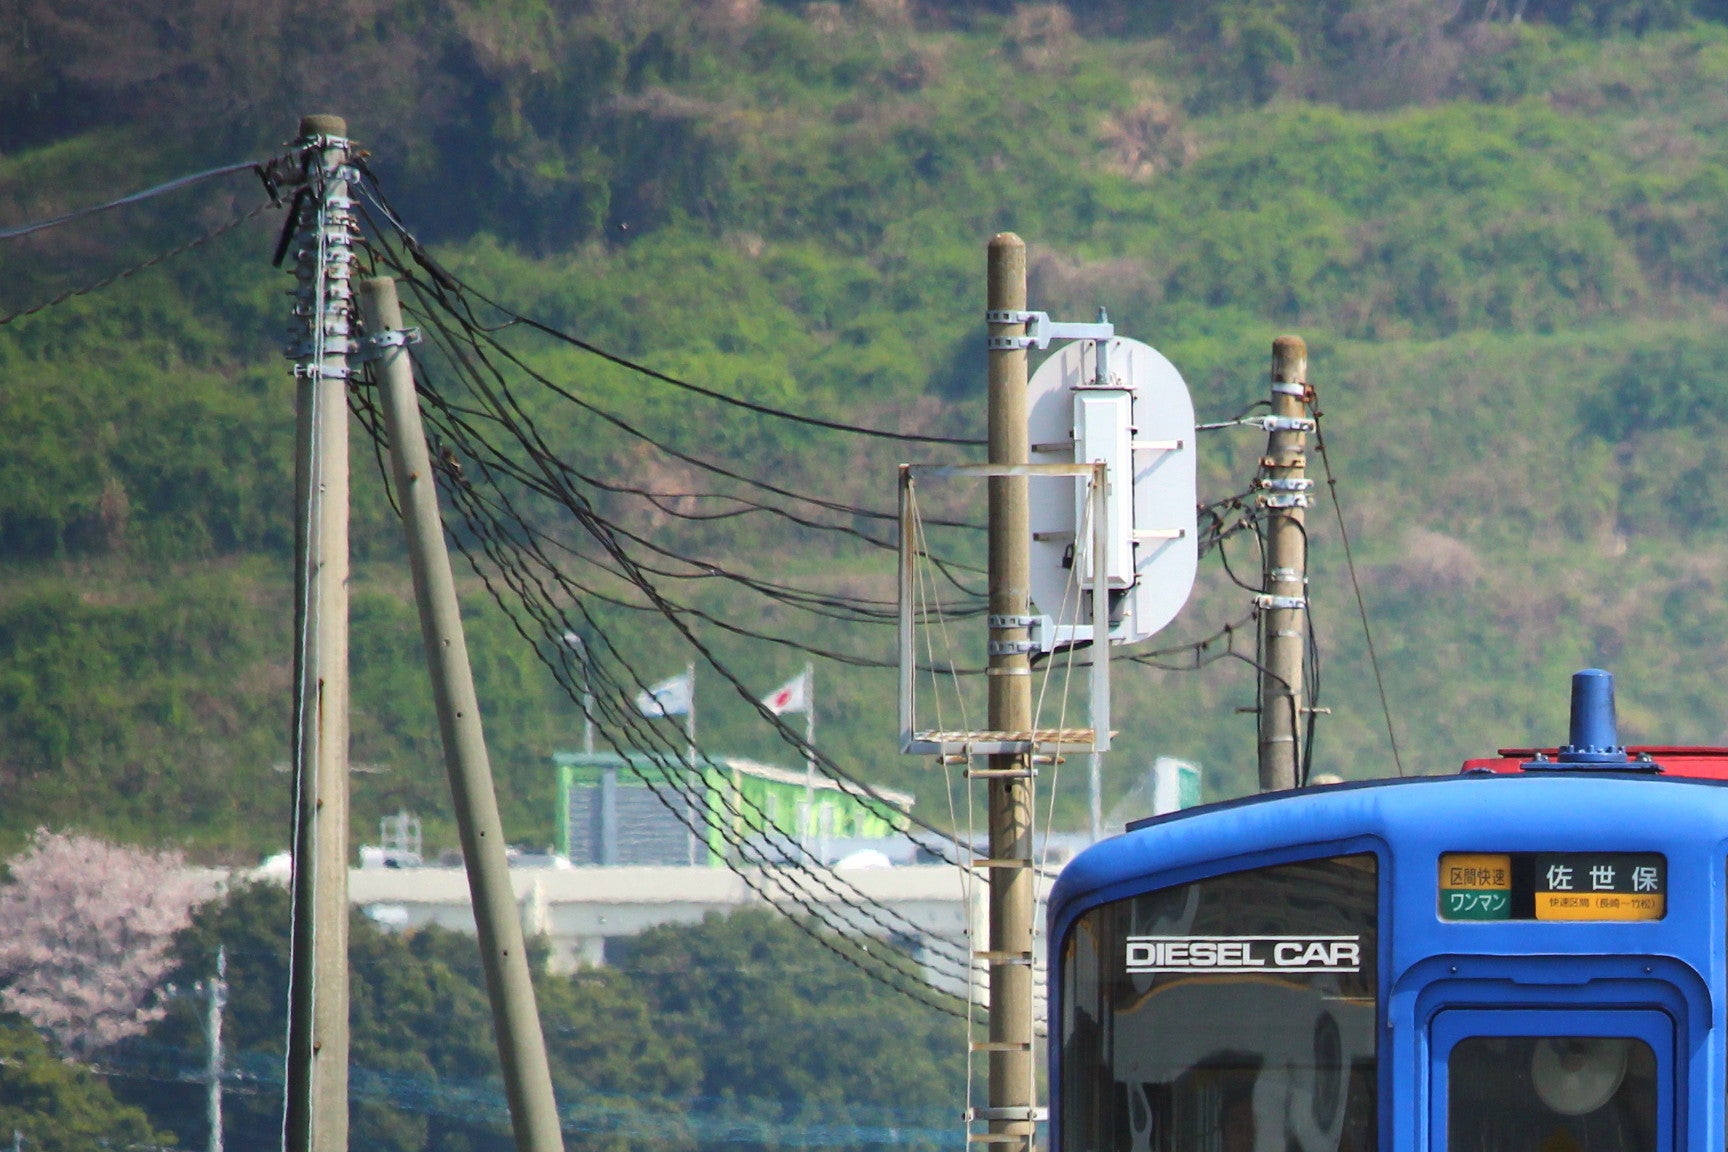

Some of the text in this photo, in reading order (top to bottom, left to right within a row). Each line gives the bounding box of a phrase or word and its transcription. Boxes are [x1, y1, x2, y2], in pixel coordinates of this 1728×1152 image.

[1451, 867, 1505, 886] 区間快速
[1546, 865, 1658, 891] 佐世保
[1451, 893, 1506, 911] ワンマン
[1126, 942, 1360, 966] DIESEL CAR
